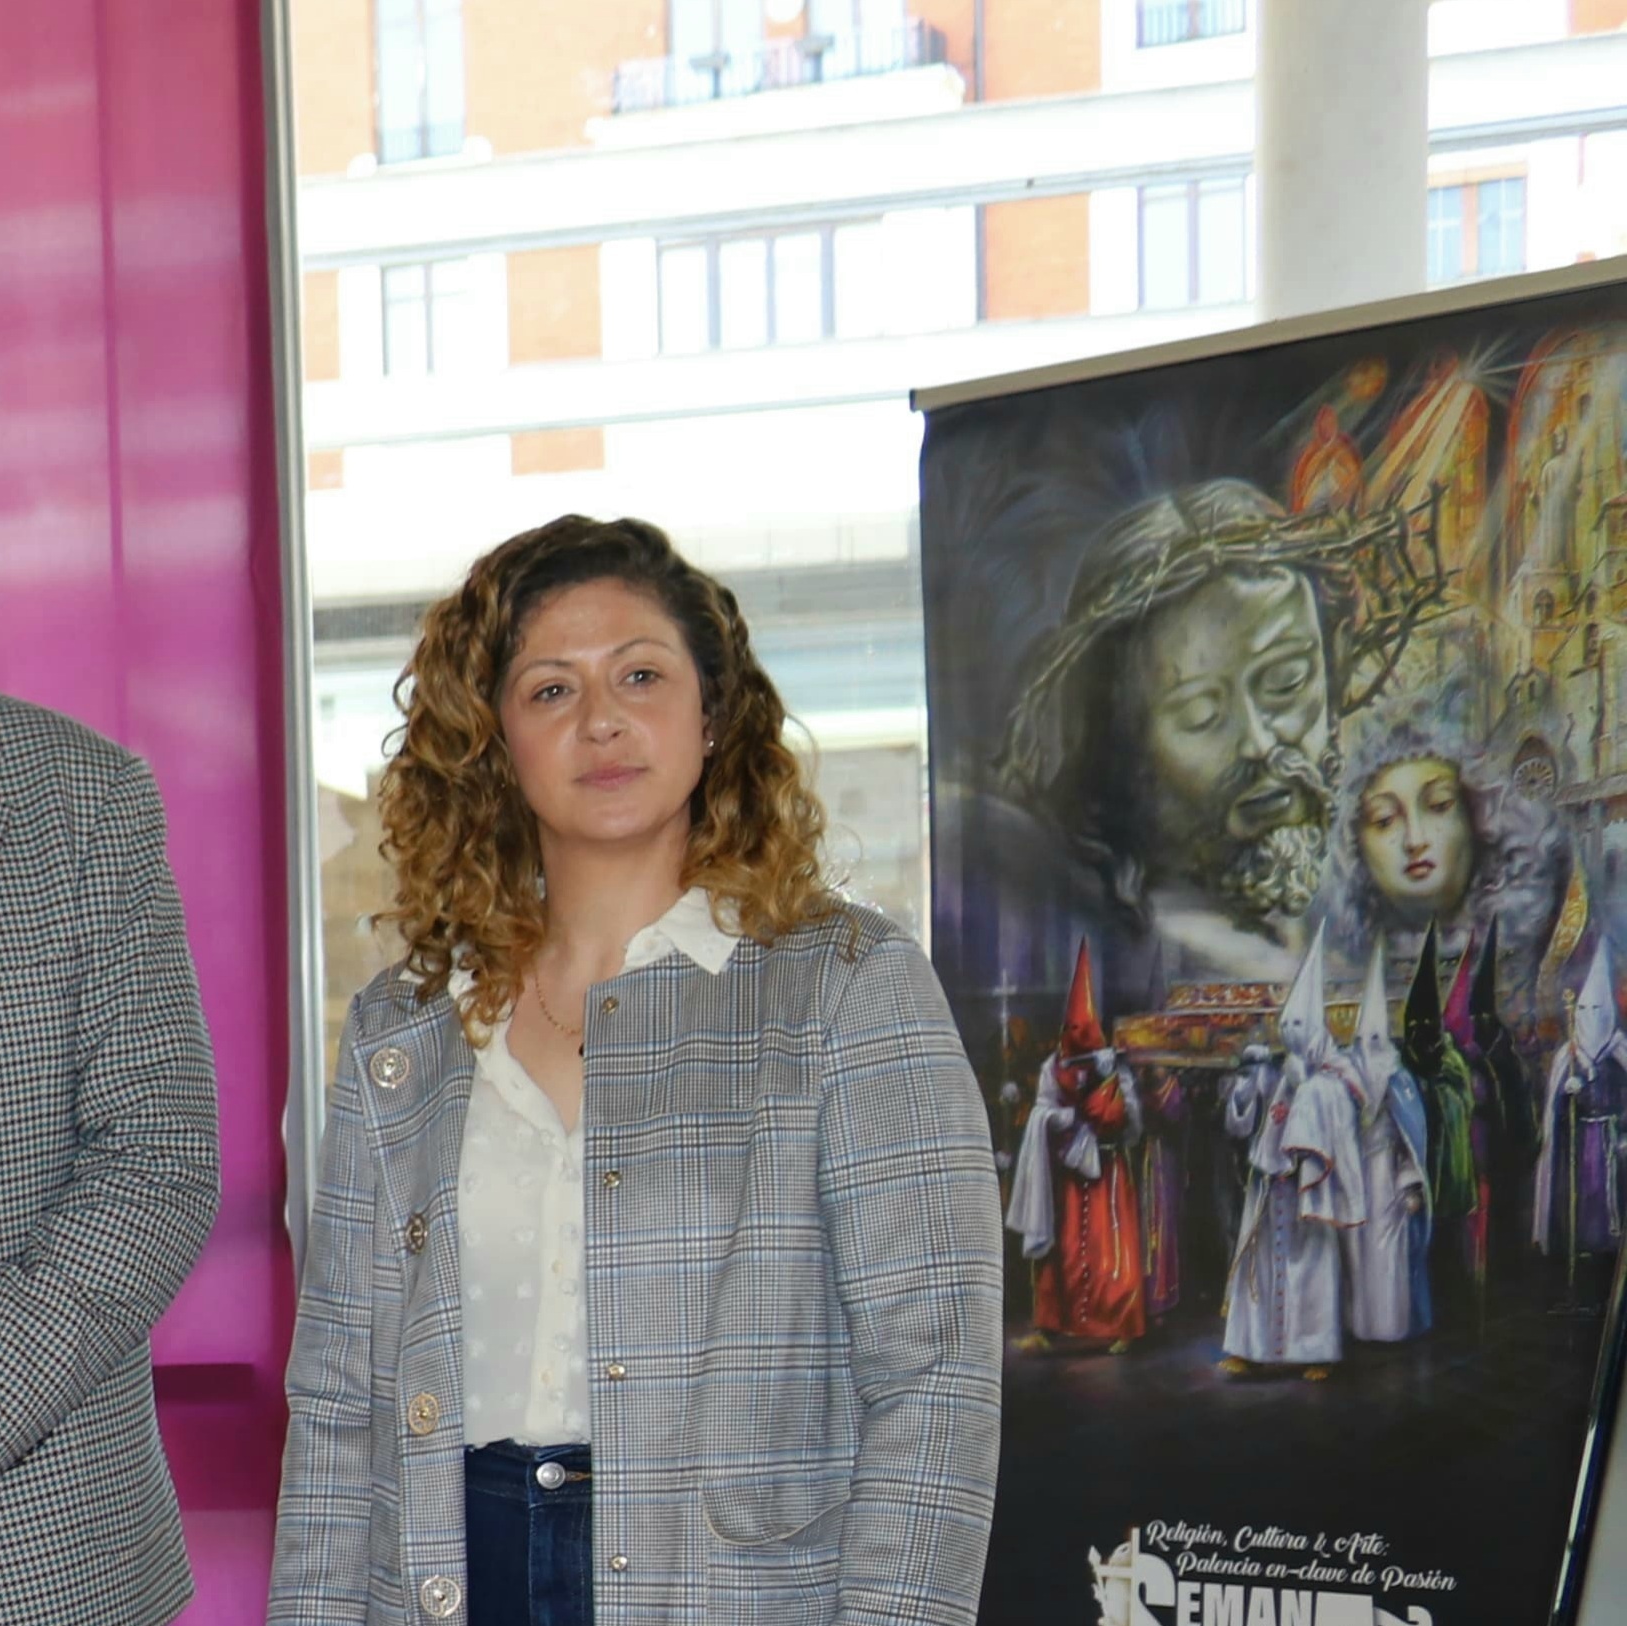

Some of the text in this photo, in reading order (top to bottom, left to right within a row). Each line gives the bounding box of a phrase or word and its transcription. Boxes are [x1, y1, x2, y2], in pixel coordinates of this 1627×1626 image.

[1146, 1519, 1228, 1552] Religión,
[1234, 1525, 1309, 1553] Cultura
[1176, 1551, 1262, 1577] Palencia
[1350, 1563, 1376, 1585] de
[1381, 1565, 1458, 1592] Pasión
